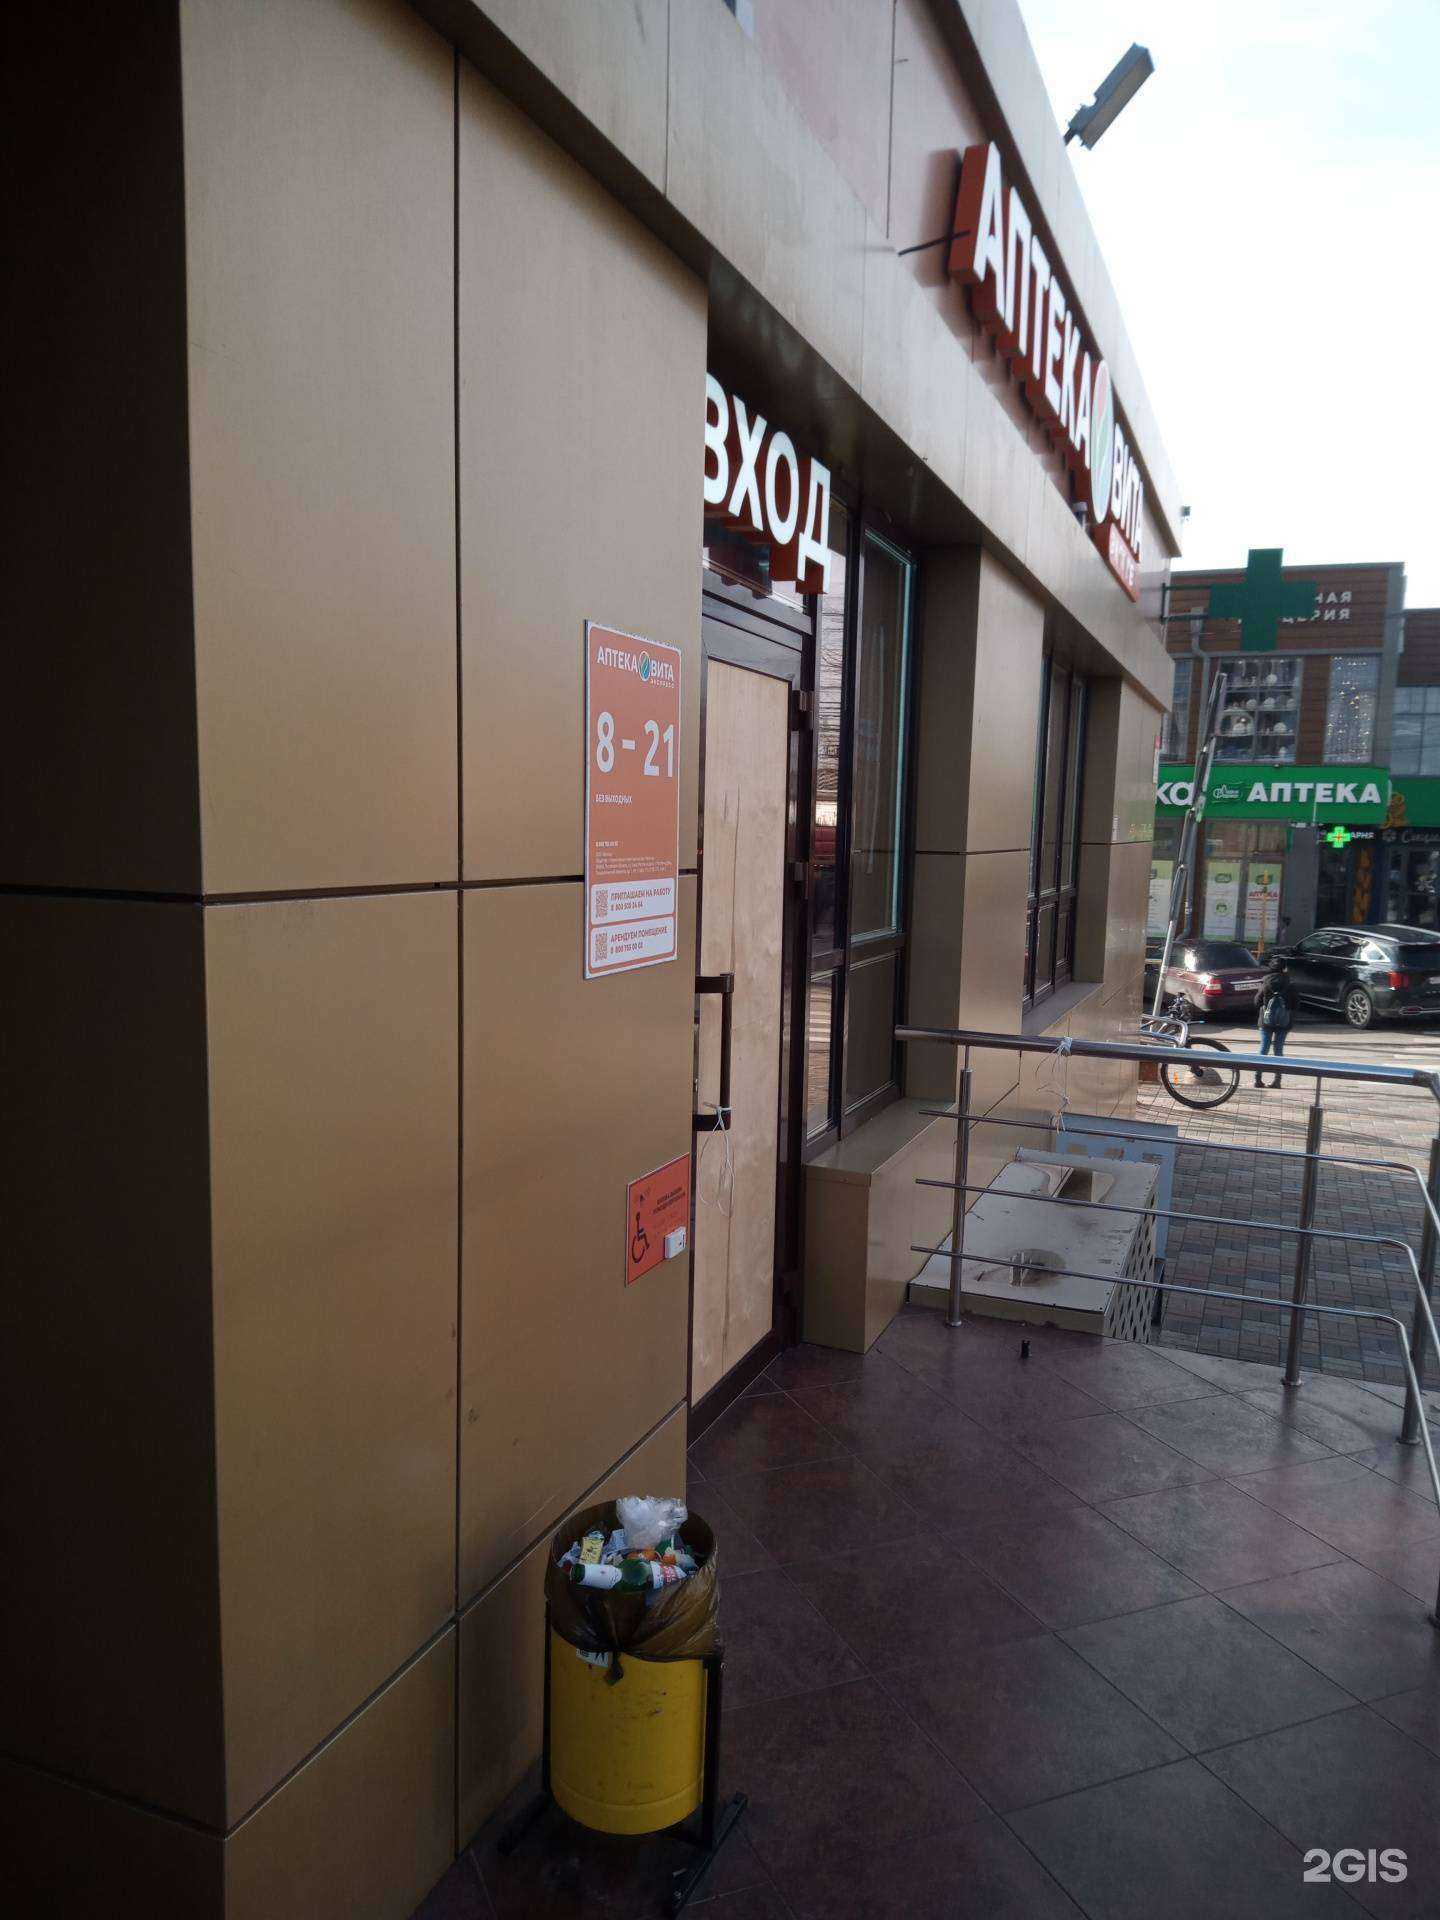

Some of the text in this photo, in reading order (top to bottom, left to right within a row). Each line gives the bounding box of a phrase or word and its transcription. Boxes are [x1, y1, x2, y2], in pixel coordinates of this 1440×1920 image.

[973, 140, 1091, 470] АПТЕКА
[1110, 422, 1144, 564] ВИТА
[704, 371, 831, 594] ВХОД
[597, 645, 675, 681] АПТЕКА ВИТА
[597, 711, 615, 773] 8
[643, 719, 674, 778] 21
[1247, 782, 1381, 804] АПТЕКА
[654, 886, 672, 897] РАБОТУ
